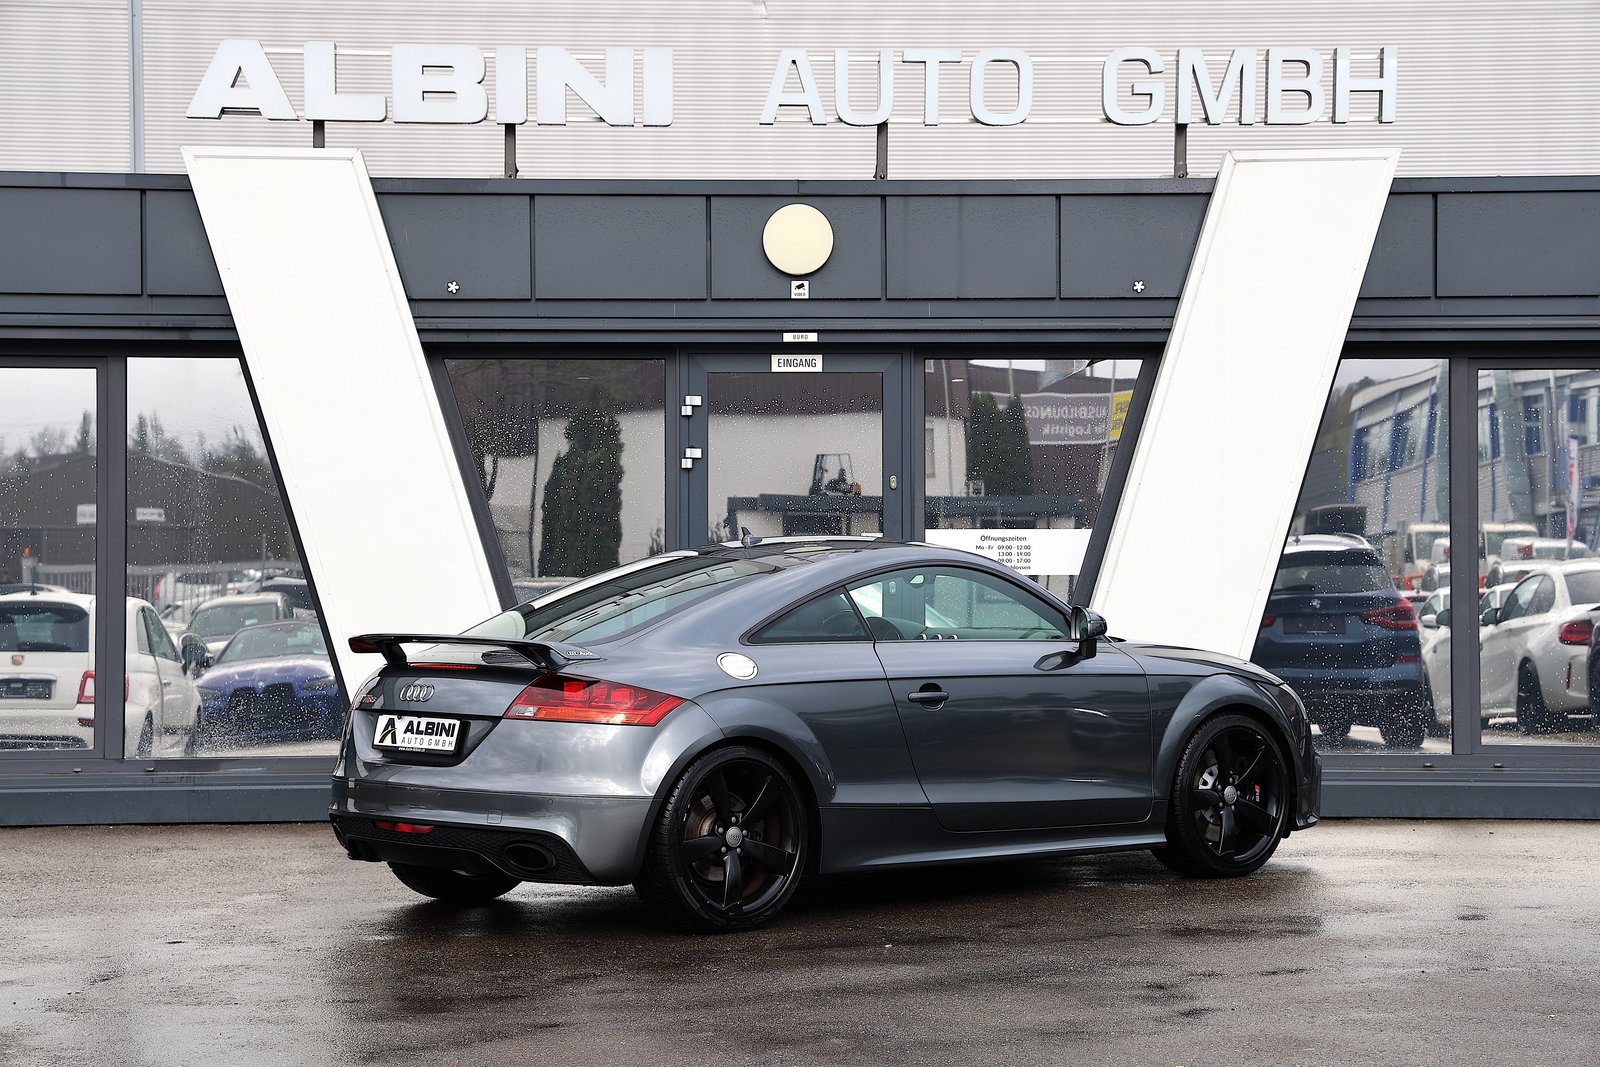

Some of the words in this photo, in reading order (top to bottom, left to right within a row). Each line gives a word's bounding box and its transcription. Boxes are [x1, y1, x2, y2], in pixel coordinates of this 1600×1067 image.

[185, 39, 673, 126] ALBINI
[759, 47, 1033, 126] AUTO
[1101, 46, 1398, 126] GMBH
[777, 358, 817, 368] EINGANG
[404, 720, 456, 737] ALBINI
[401, 736, 425, 746] AUTO
[427, 738, 453, 748] GMBH
